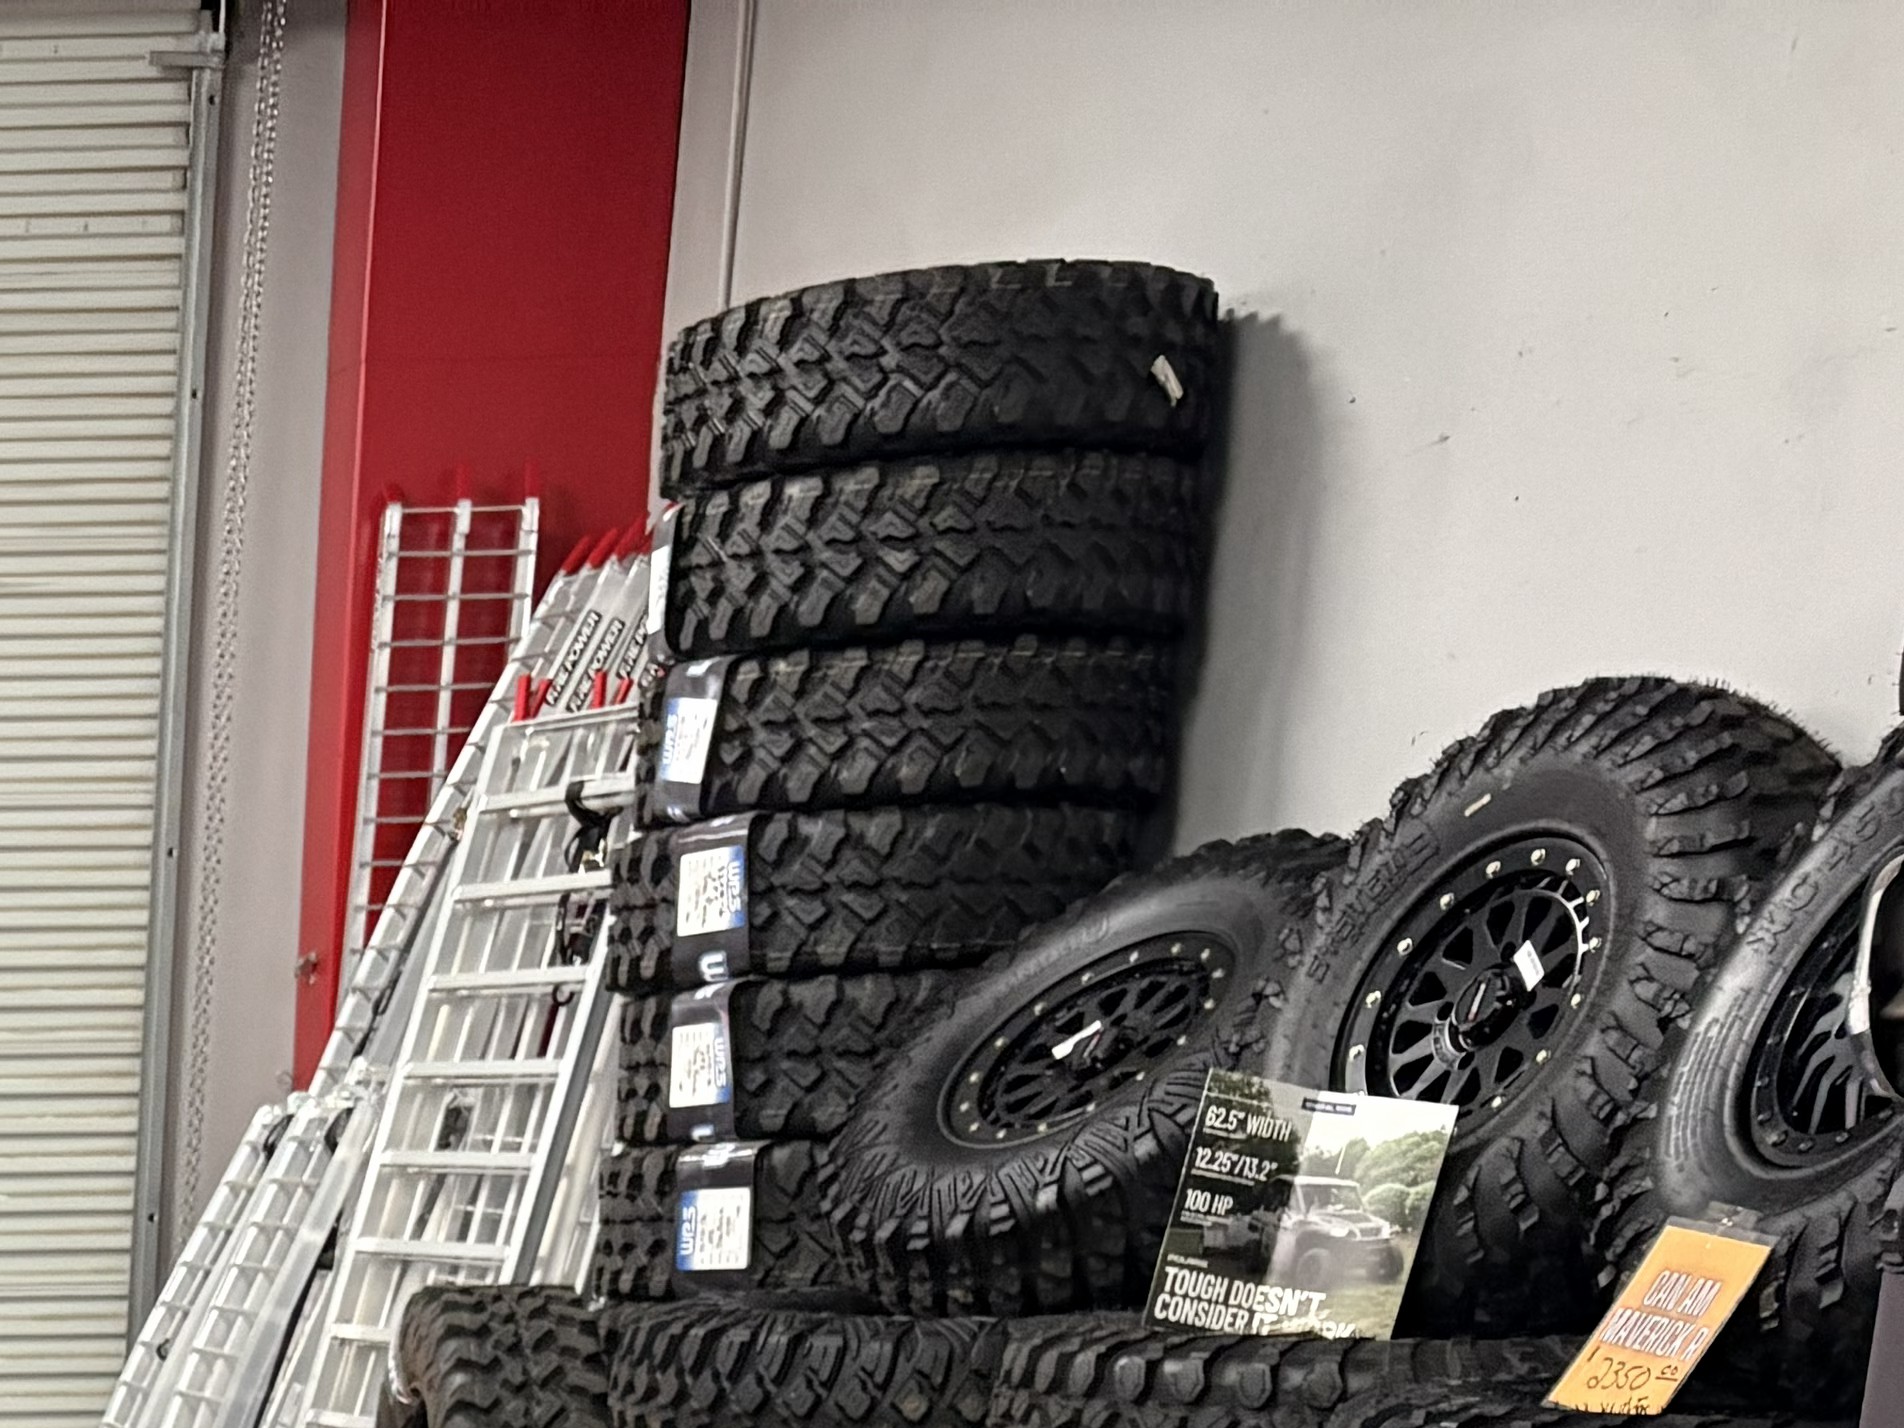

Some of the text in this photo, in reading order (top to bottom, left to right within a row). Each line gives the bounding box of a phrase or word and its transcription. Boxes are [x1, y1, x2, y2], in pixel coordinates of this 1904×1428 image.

[1247, 1114, 1293, 1142] WIDTH
[1184, 1188, 1234, 1215] 100 HP
[1154, 1293, 1249, 1334] CONSIDER
[1164, 1266, 1327, 1318] TOUGH DOESN'T
[1643, 1269, 1723, 1317] CAN AM
[1599, 1307, 1698, 1359] MAVERICK
